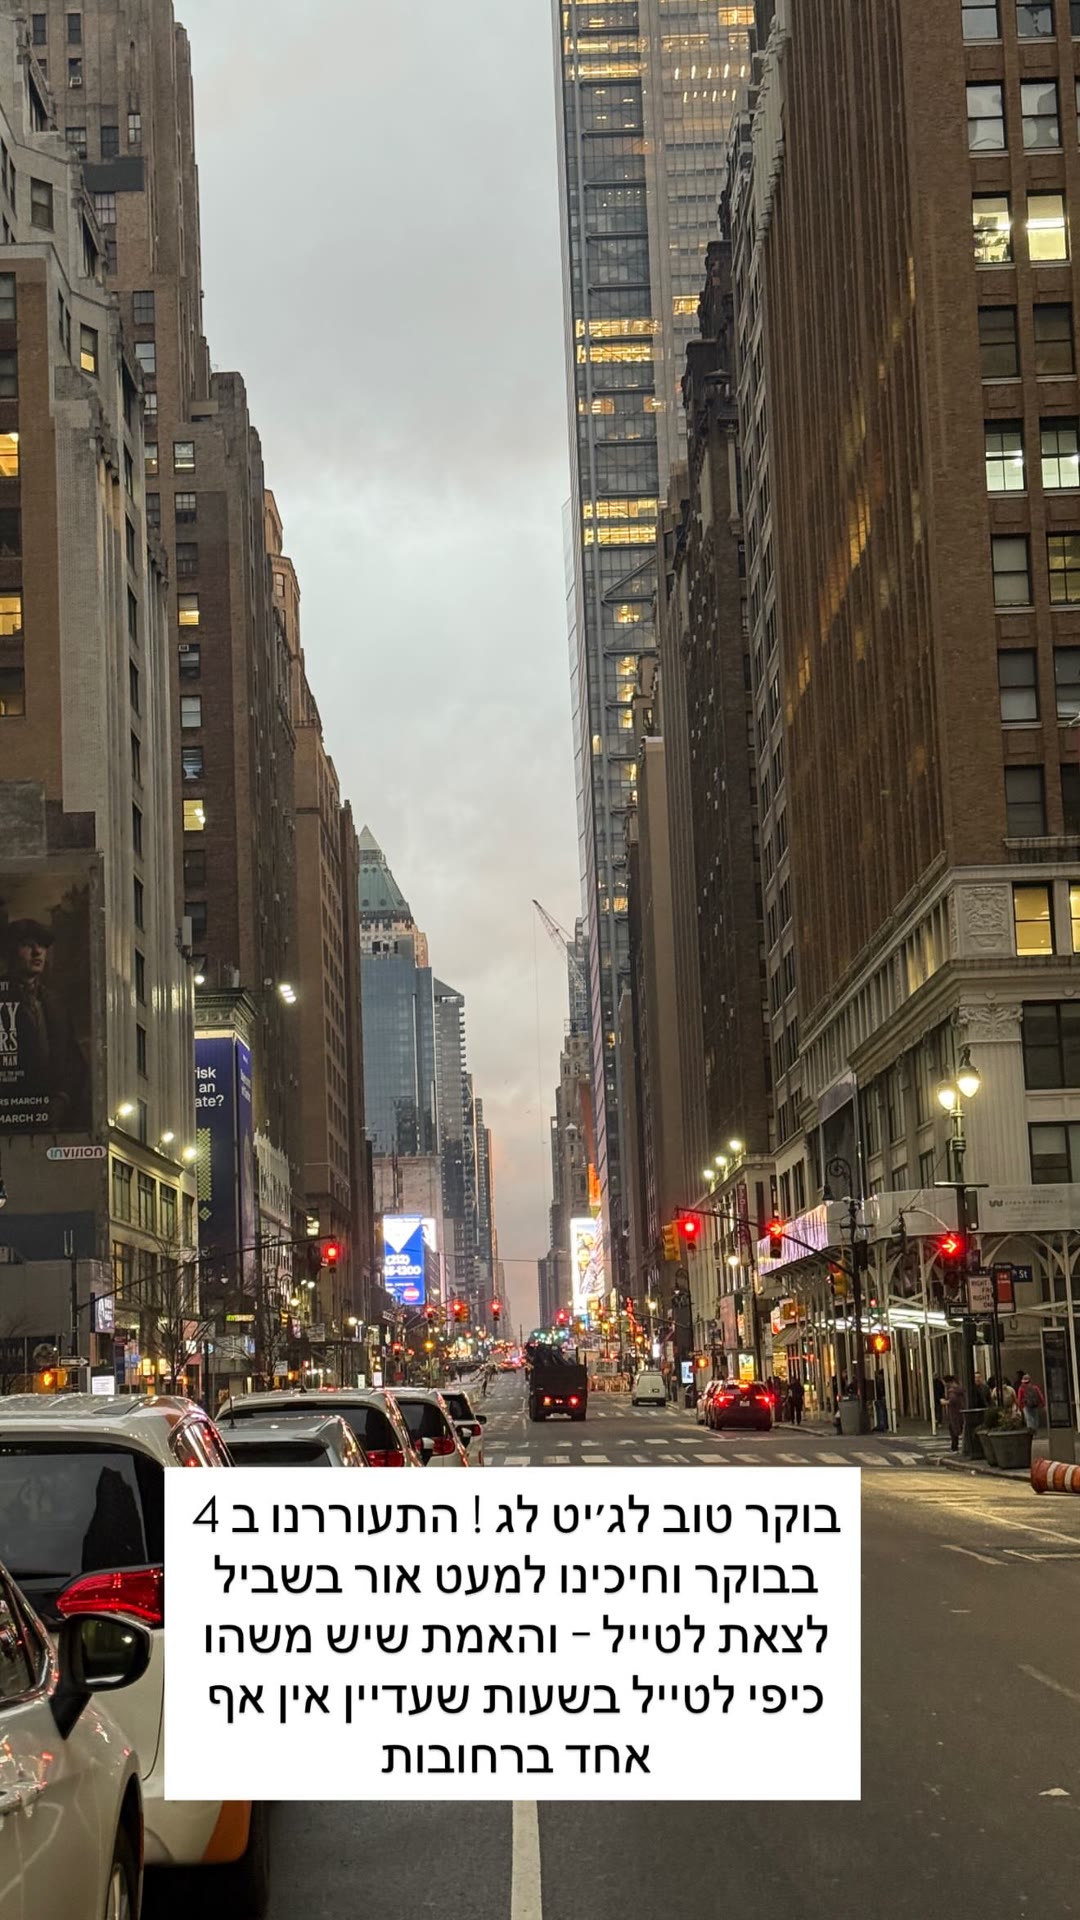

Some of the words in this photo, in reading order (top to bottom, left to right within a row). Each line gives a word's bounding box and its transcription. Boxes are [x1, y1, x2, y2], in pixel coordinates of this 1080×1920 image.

[199, 1083, 216, 1093] an
[10, 1096, 42, 1105] MARCH
[43, 1096, 50, 1104] 6
[35, 1112, 48, 1121] 20
[1018, 1270, 1028, 1279] St
